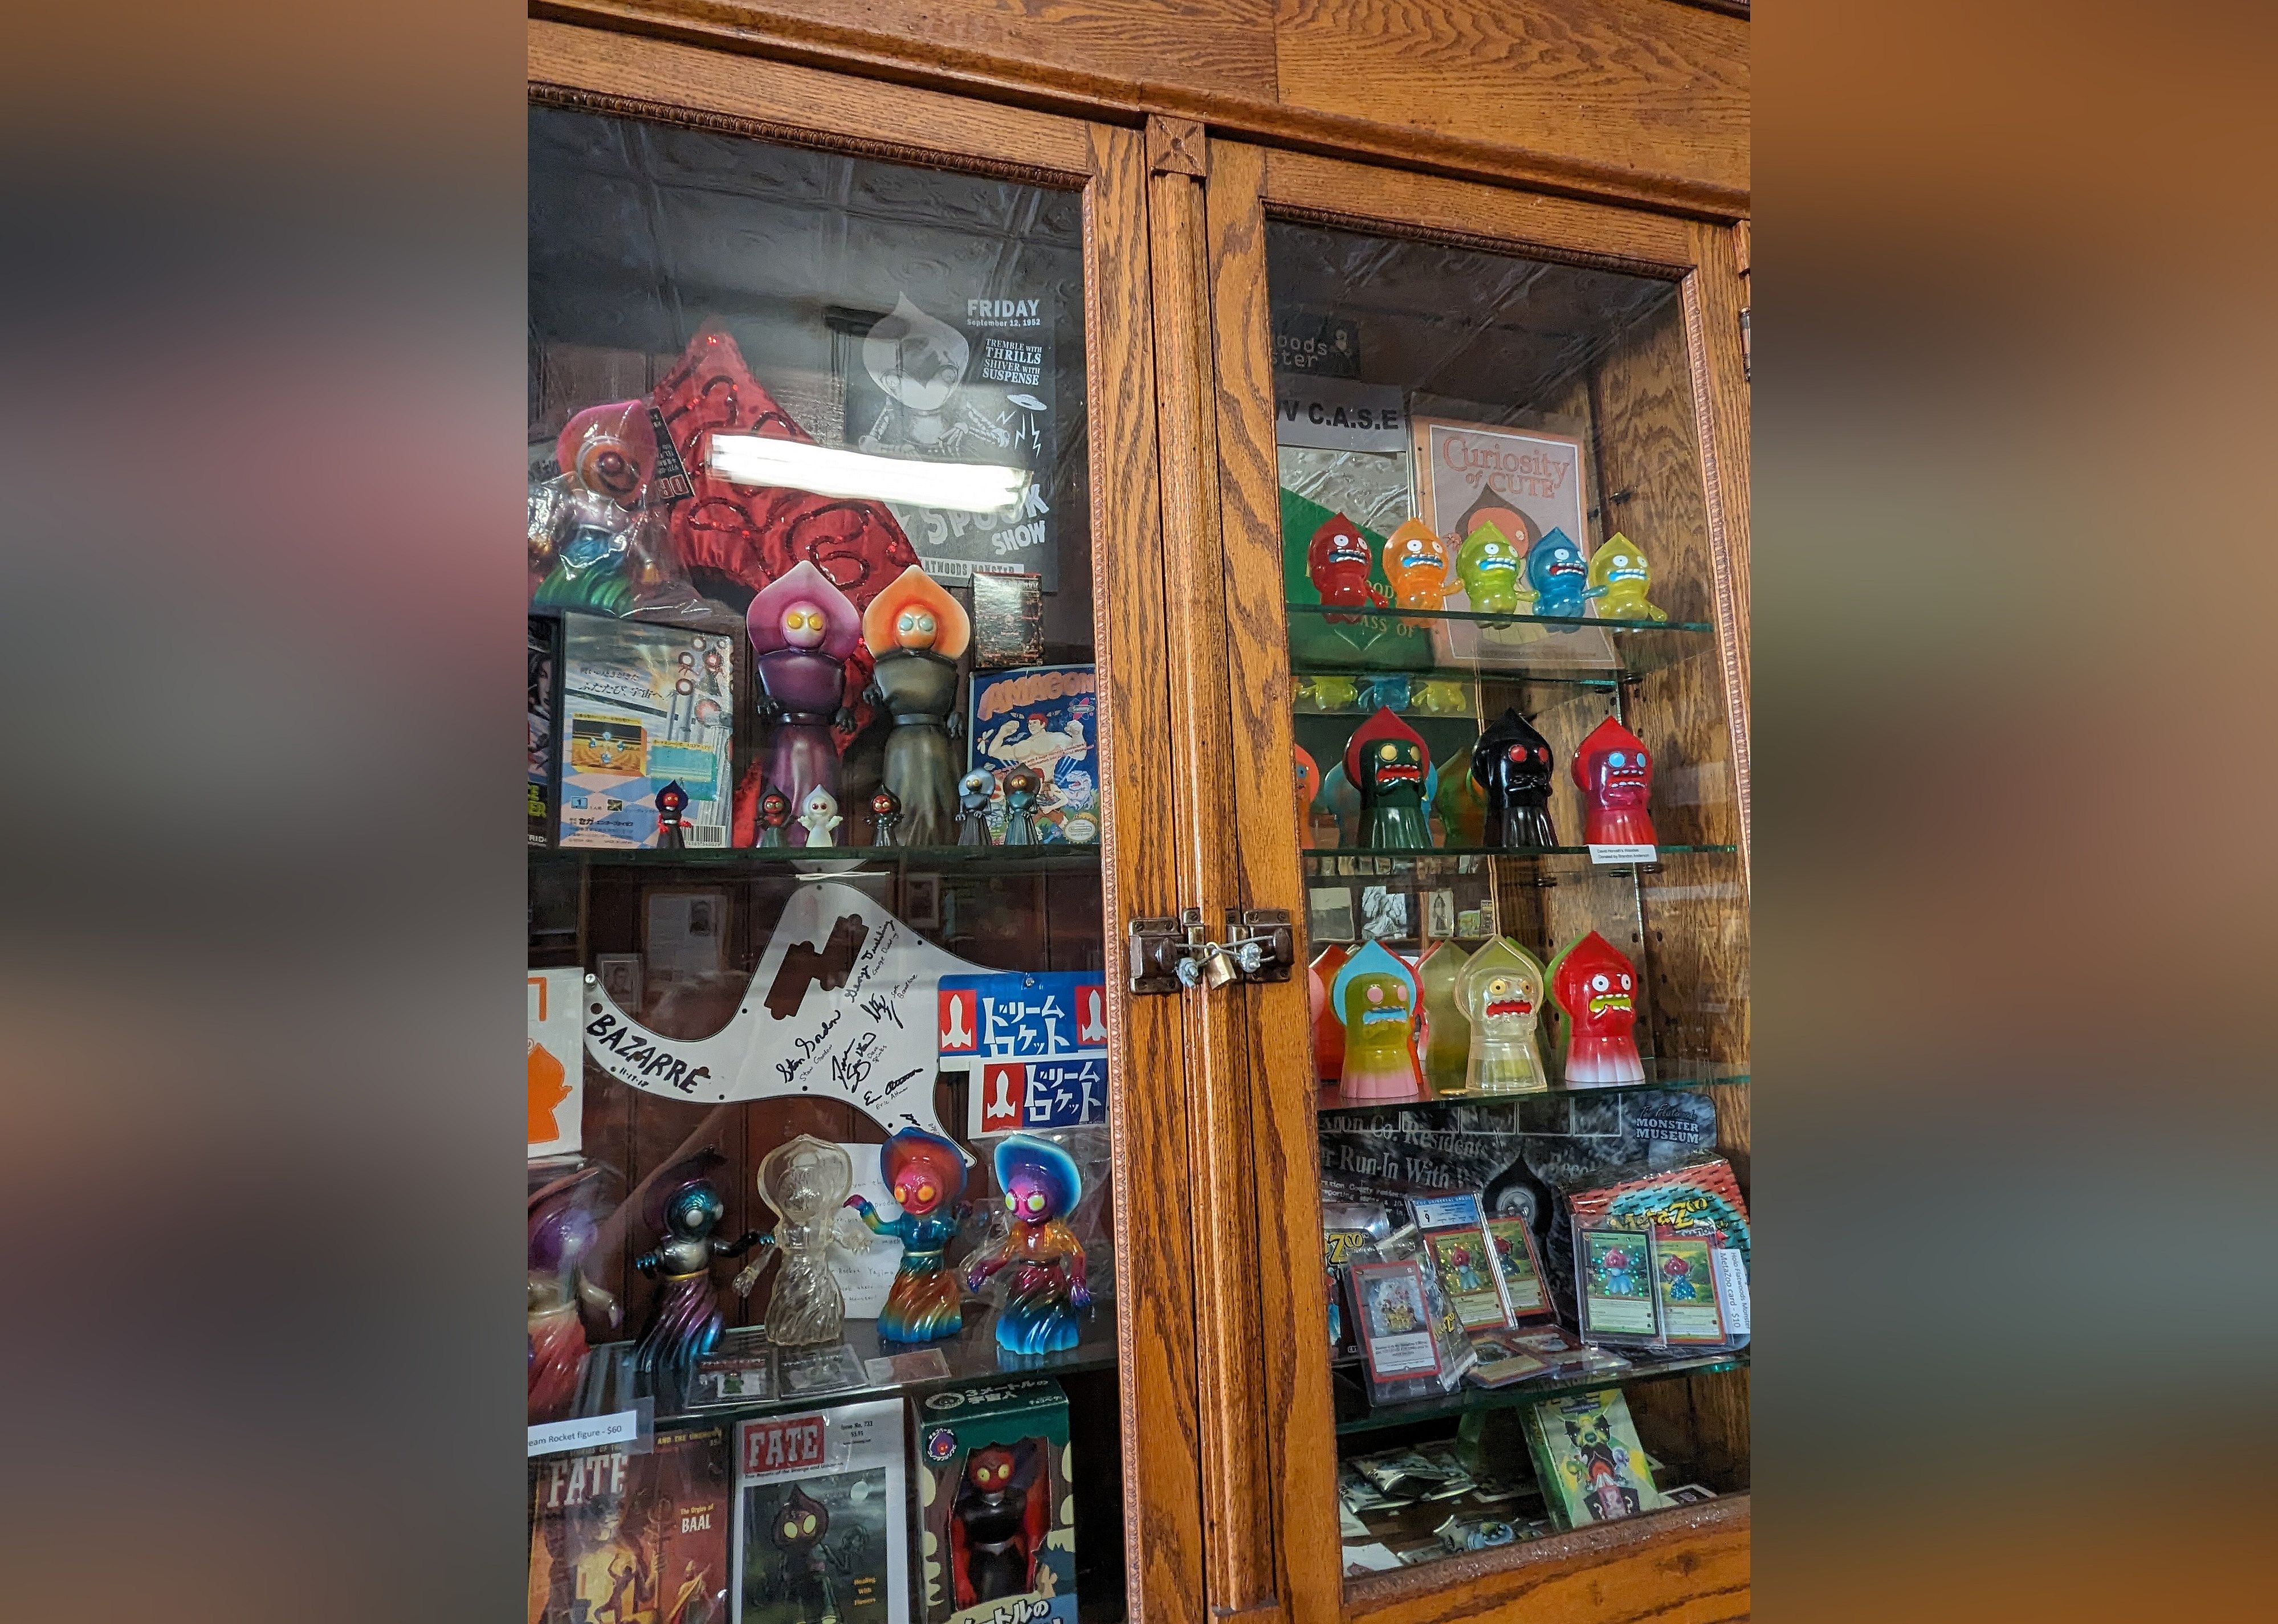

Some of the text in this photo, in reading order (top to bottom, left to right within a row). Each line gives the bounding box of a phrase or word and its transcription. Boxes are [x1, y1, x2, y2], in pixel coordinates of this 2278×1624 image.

[968, 299, 1040, 317] FRIDAY
[986, 338, 1024, 351] TREMBLE
[986, 346, 1042, 364] THRILLS
[985, 359, 1040, 374] SHIVER WITH
[983, 368, 1040, 385] SUSPENSE
[1308, 402, 1399, 430] C.A.S.E
[1443, 435, 1570, 488] Curiosity
[1465, 471, 1555, 499] of CUTE
[991, 520, 1045, 555] SHOW
[586, 1014, 711, 1093] BAZARRE
[1636, 1118, 1699, 1132] MONSTER
[1636, 1128, 1699, 1144] MUSEUM
[1406, 1157, 1449, 1190] With
[1425, 1213, 1430, 1223] 9
[1720, 1252, 1731, 1287] MetaZoo
[1735, 1268, 1745, 1301] Flatwoods
[1728, 1288, 1737, 1306] card
[1732, 1313, 1741, 1328] $10
[548, 1433, 575, 1443] Rocket
[577, 1430, 600, 1439] figure
[607, 1425, 622, 1435] $60
[749, 1425, 818, 1467] FATE
[547, 1453, 628, 1508] FATE
[682, 1514, 711, 1533] BAAL
